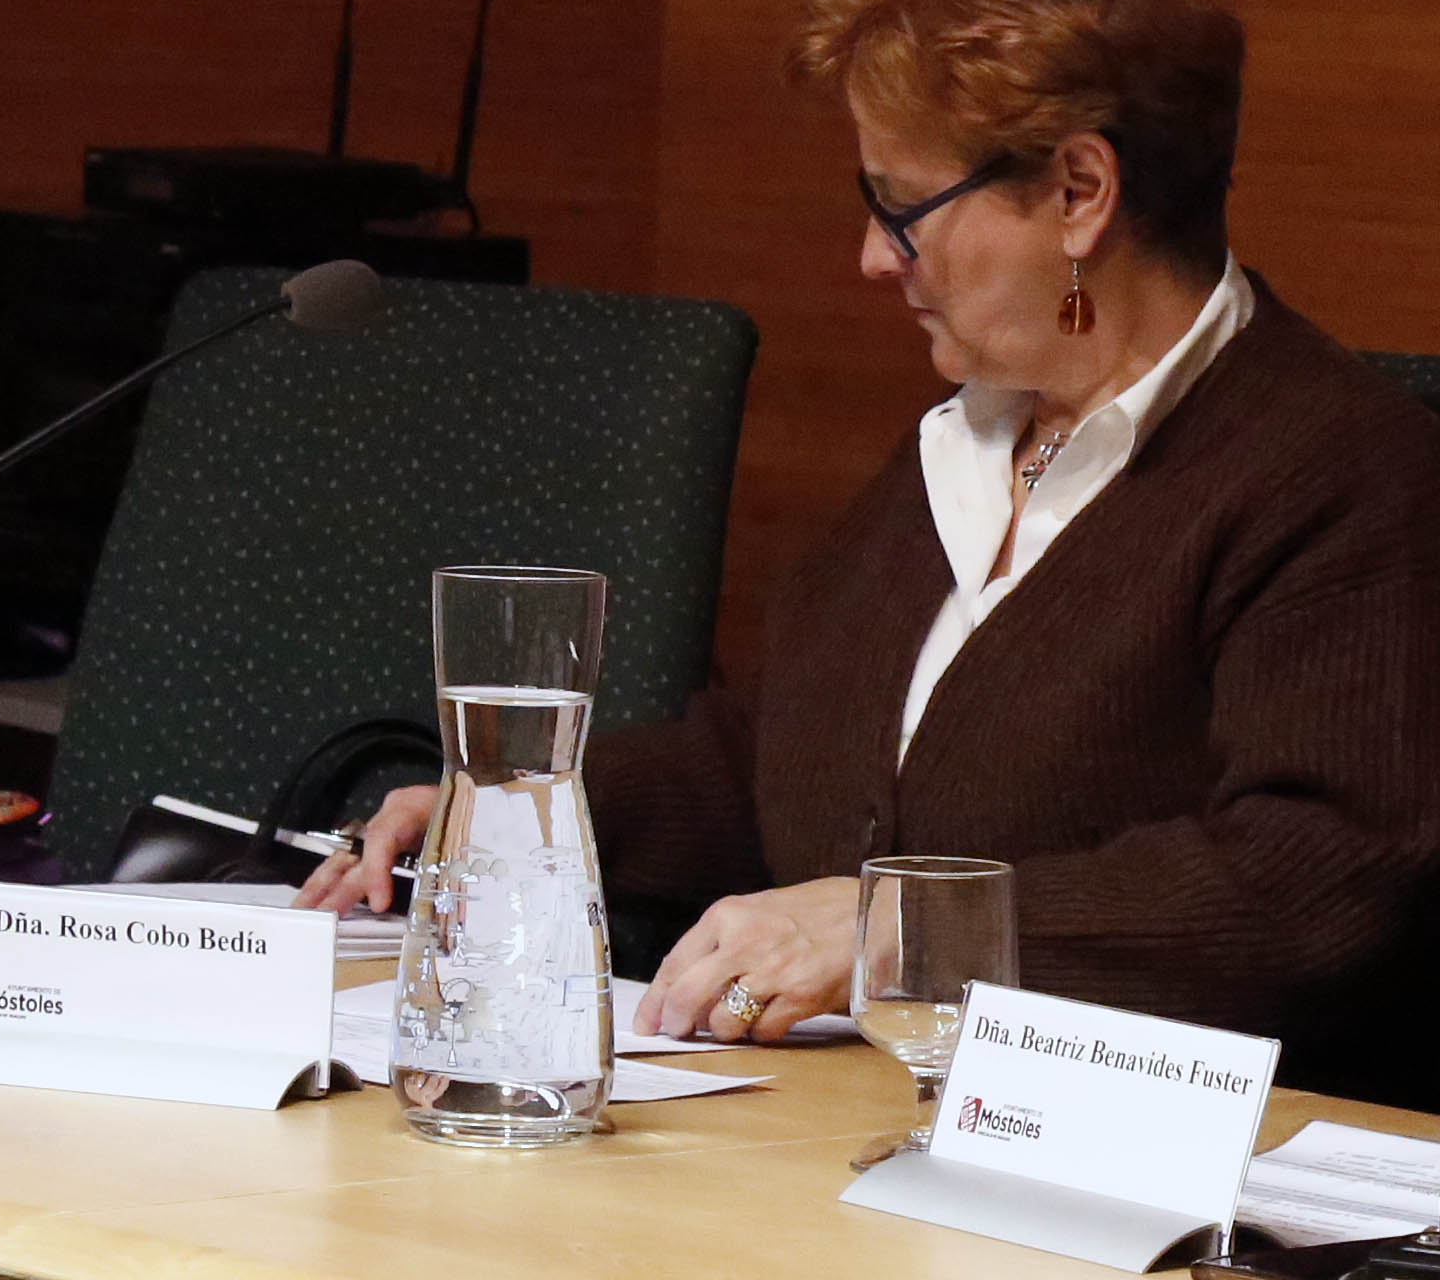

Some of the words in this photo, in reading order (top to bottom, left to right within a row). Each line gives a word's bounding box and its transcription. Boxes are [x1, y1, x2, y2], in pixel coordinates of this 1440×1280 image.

[59, 914, 117, 942] Rosa
[126, 920, 191, 949] Cobo
[198, 926, 268, 955] Bedía
[974, 1015, 1014, 1047] Dña.
[1019, 1024, 1086, 1062] Beatriz
[1089, 1039, 1184, 1082] Benavides
[1187, 1059, 1254, 1096] Fuster
[978, 1107, 1042, 1140] Móstoles
